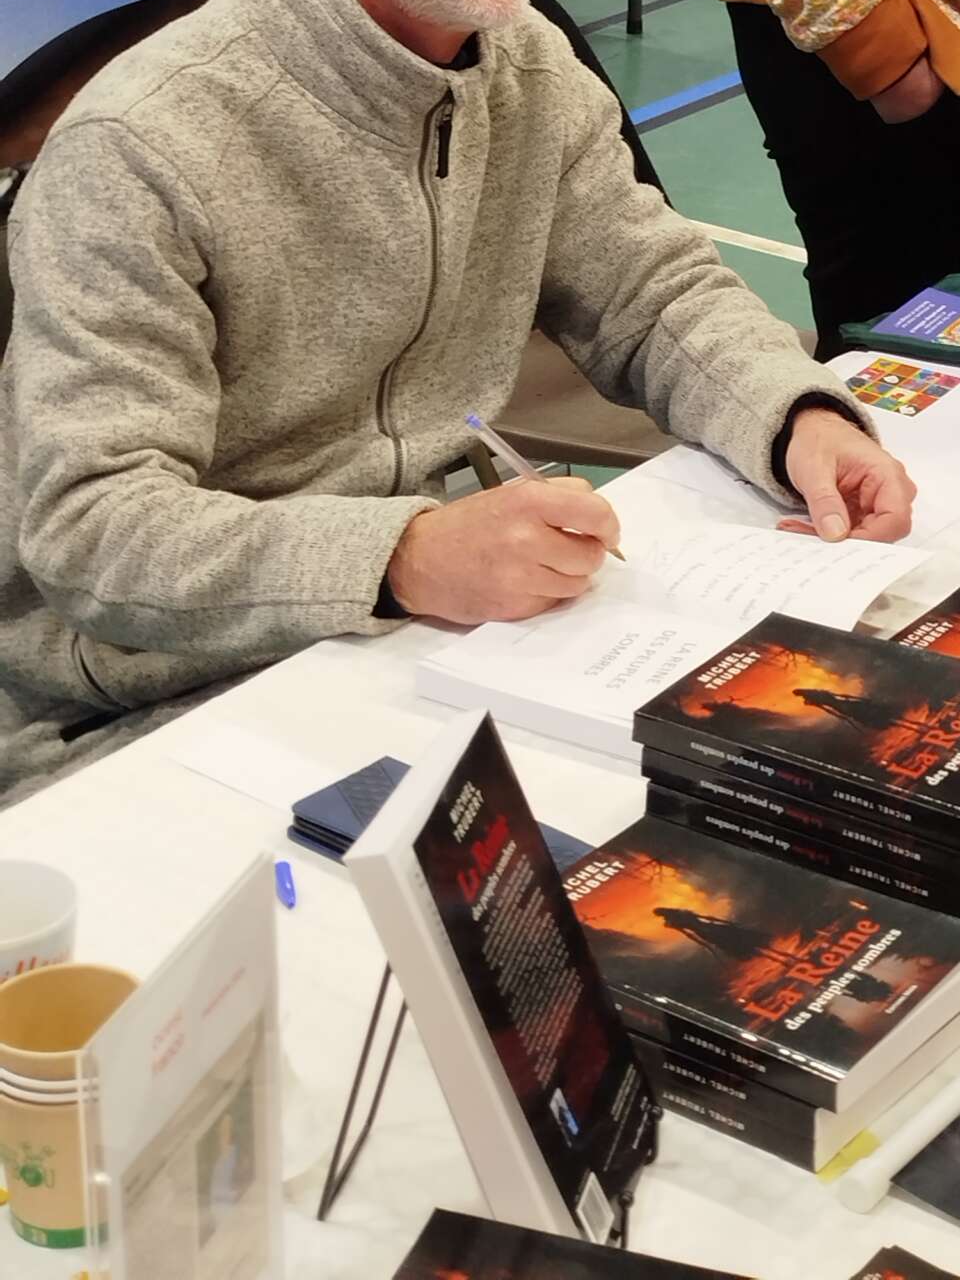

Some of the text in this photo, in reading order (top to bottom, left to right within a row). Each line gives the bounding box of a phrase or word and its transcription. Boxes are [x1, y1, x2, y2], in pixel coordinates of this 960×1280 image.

[696, 649, 747, 685] MICHEL
[704, 649, 763, 691] TRUBERT
[890, 747, 938, 779] La
[925, 770, 949, 785] des
[562, 861, 609, 890] ICHEL
[566, 861, 626, 901] RUBERT
[745, 915, 882, 1021] La Reine
[784, 1005, 811, 1031] des
[807, 967, 857, 1013] peuples
[851, 927, 902, 973] sombres
